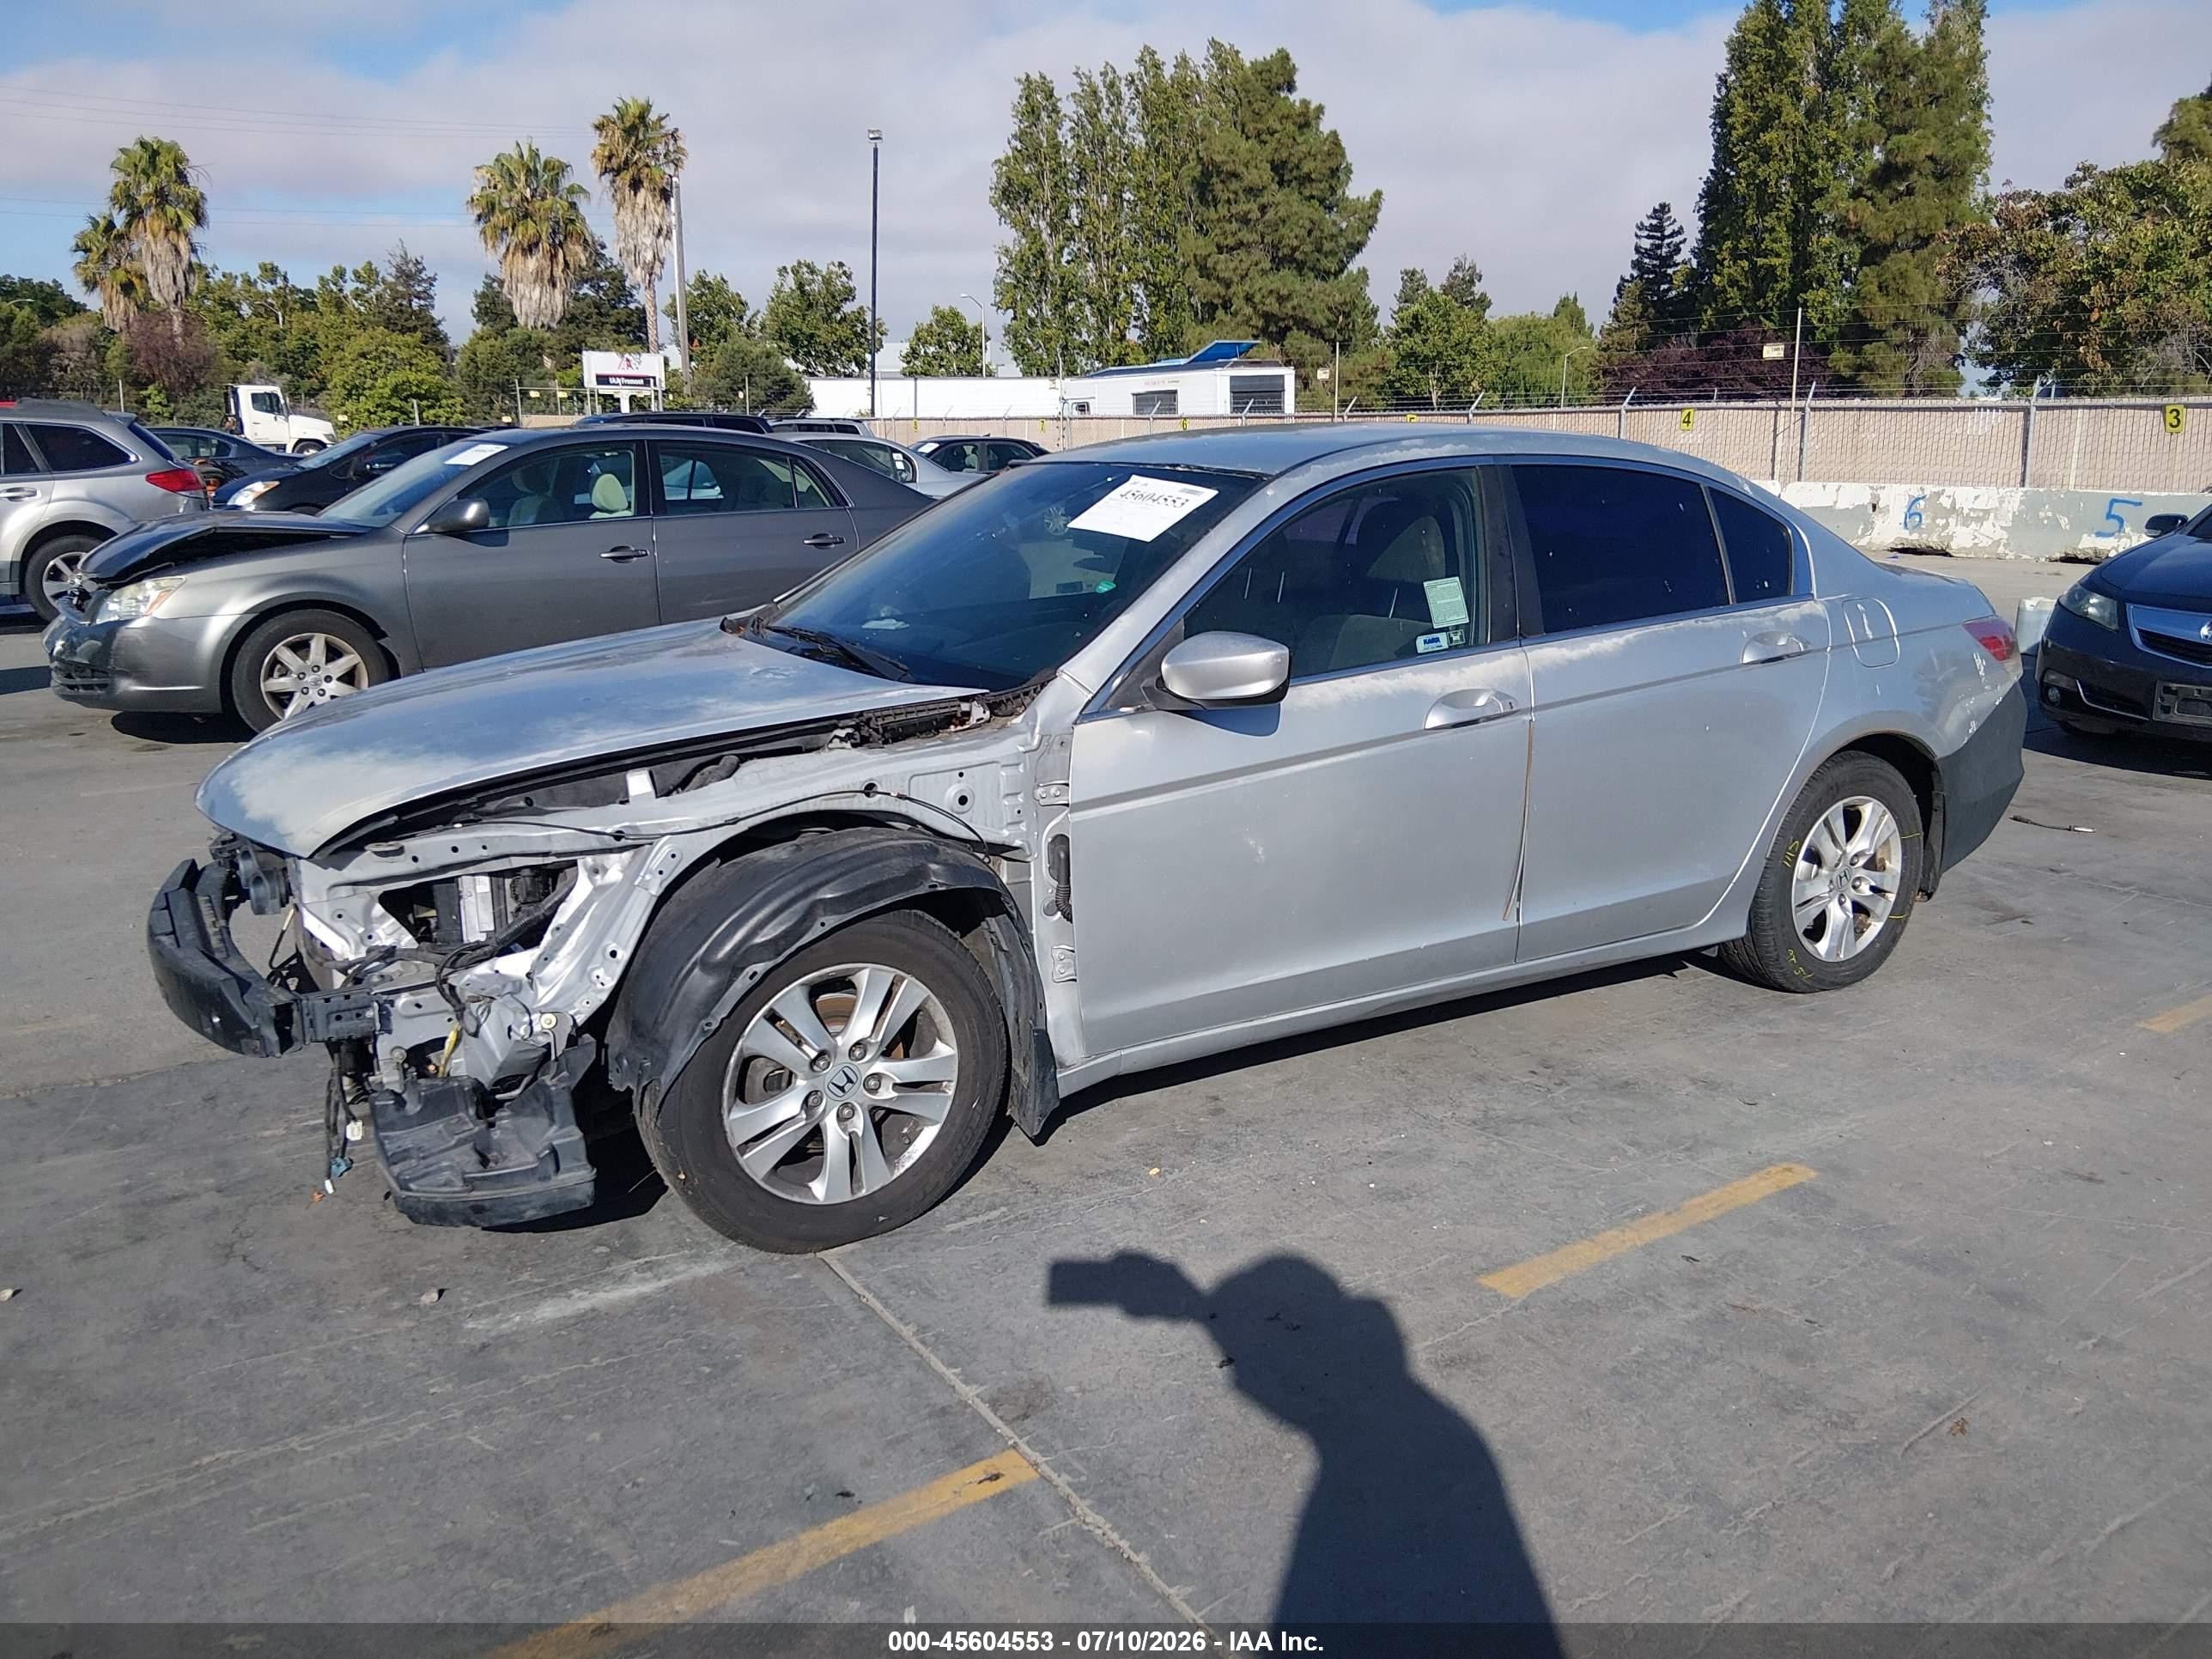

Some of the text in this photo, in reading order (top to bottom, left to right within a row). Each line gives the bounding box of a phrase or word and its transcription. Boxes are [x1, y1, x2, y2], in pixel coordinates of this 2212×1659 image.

[1682, 410, 1692, 428] 4
[2168, 408, 2181, 428] 3
[1120, 489, 1189, 508] 45604553
[1903, 494, 1927, 530] 6
[2095, 497, 2143, 538] 5
